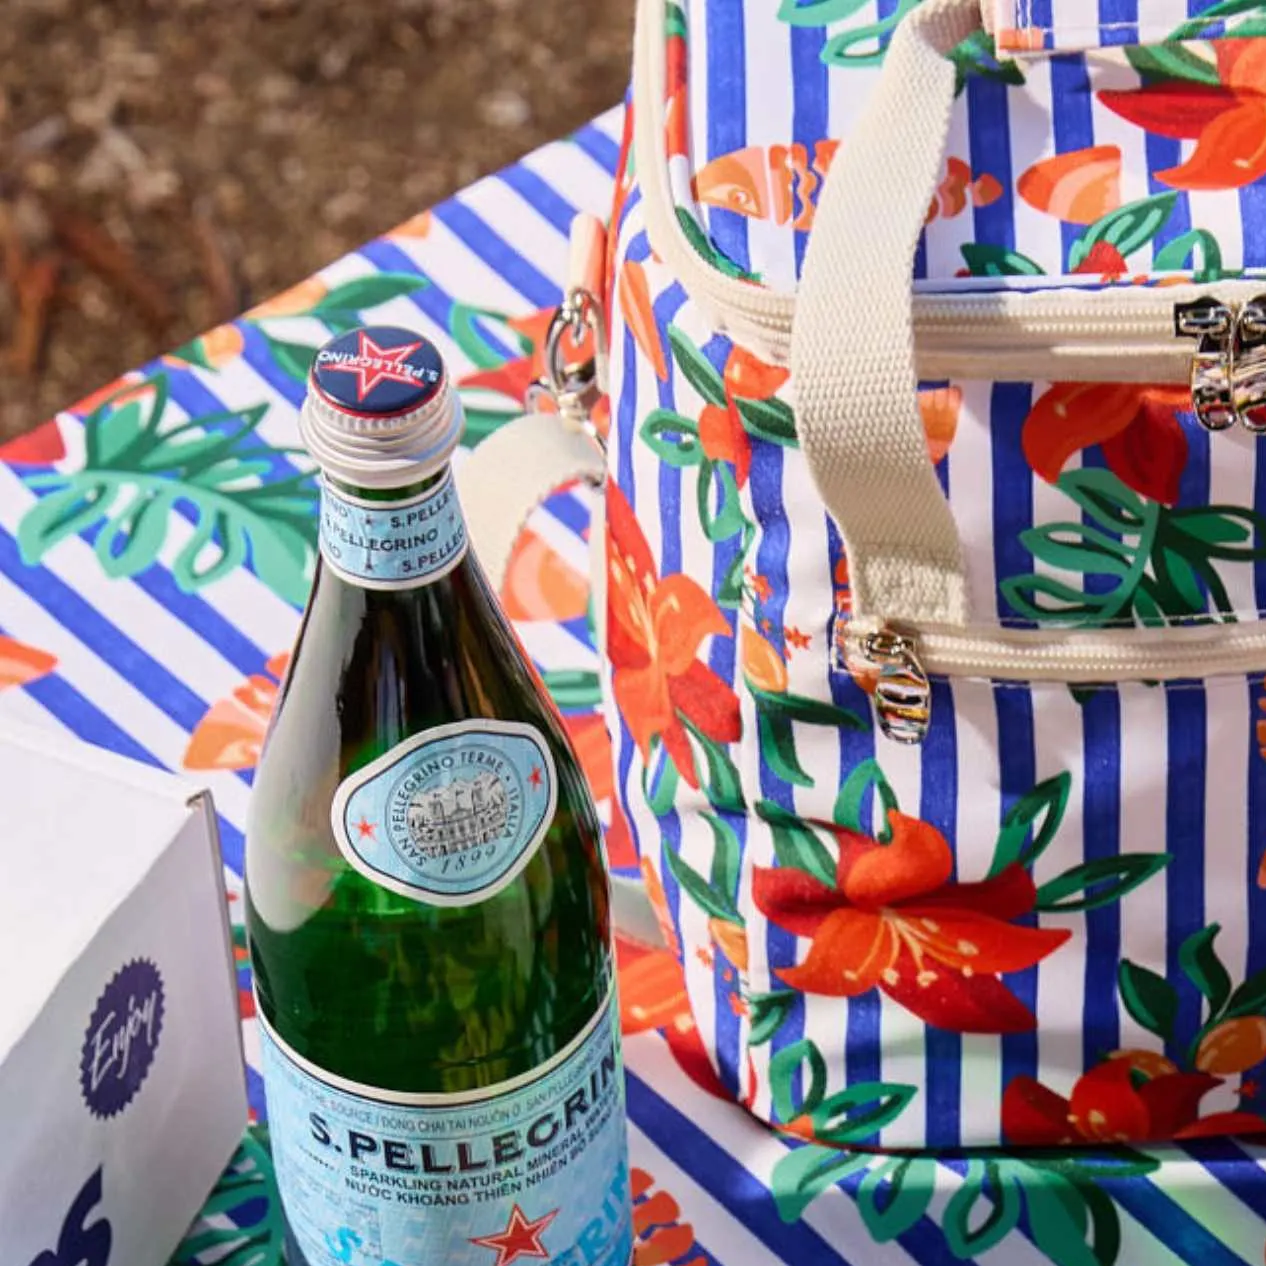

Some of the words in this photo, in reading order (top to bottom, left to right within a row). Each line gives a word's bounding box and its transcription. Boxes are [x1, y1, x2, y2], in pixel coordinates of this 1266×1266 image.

[390, 491, 453, 529] S.PELLE
[460, 750, 504, 774] TERME
[391, 755, 456, 833] PELLEGRINO
[503, 784, 519, 839] ITALIA
[401, 837, 428, 867] SAN
[441, 844, 497, 875] 1899
[88, 990, 157, 1092] Enjoy
[350, 1165, 442, 1192] SPARKLING
[447, 1166, 525, 1191] NATURAL
[527, 1128, 583, 1171] MINERAL
